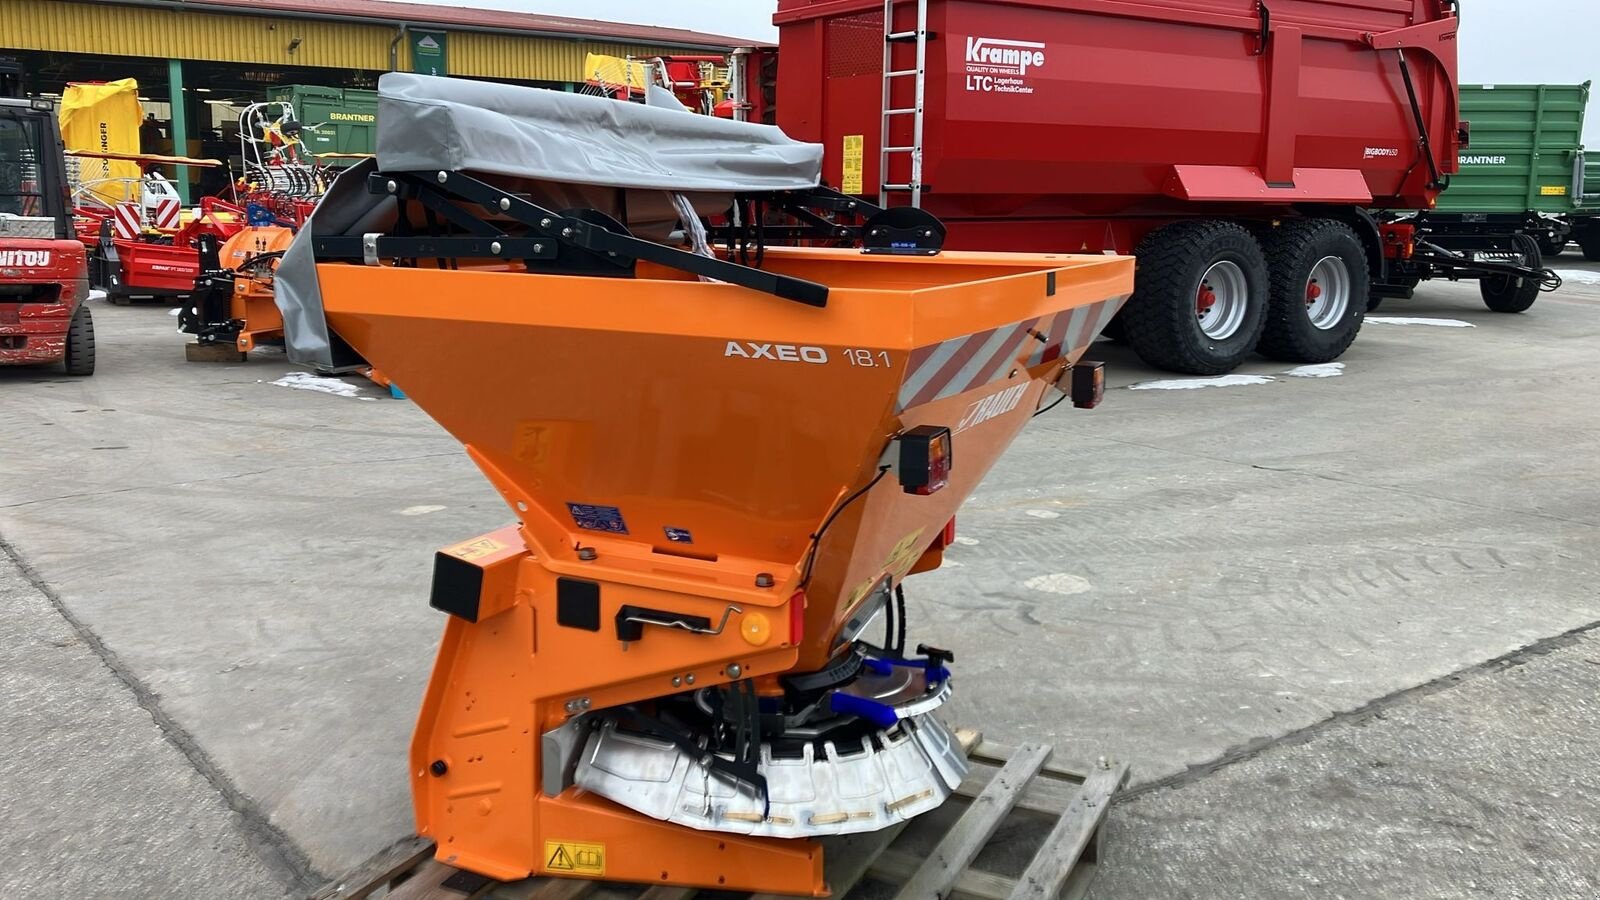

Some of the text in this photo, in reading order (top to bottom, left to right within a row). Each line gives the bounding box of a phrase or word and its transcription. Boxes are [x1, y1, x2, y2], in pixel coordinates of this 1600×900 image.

[965, 36, 1046, 76] Krampe
[966, 75, 993, 92] LTC
[994, 77, 1024, 85] Lagerhaus
[994, 85, 1034, 93] TechnikCenter
[330, 112, 375, 122] BRANTNER
[724, 341, 892, 368] AXEO 18.1
